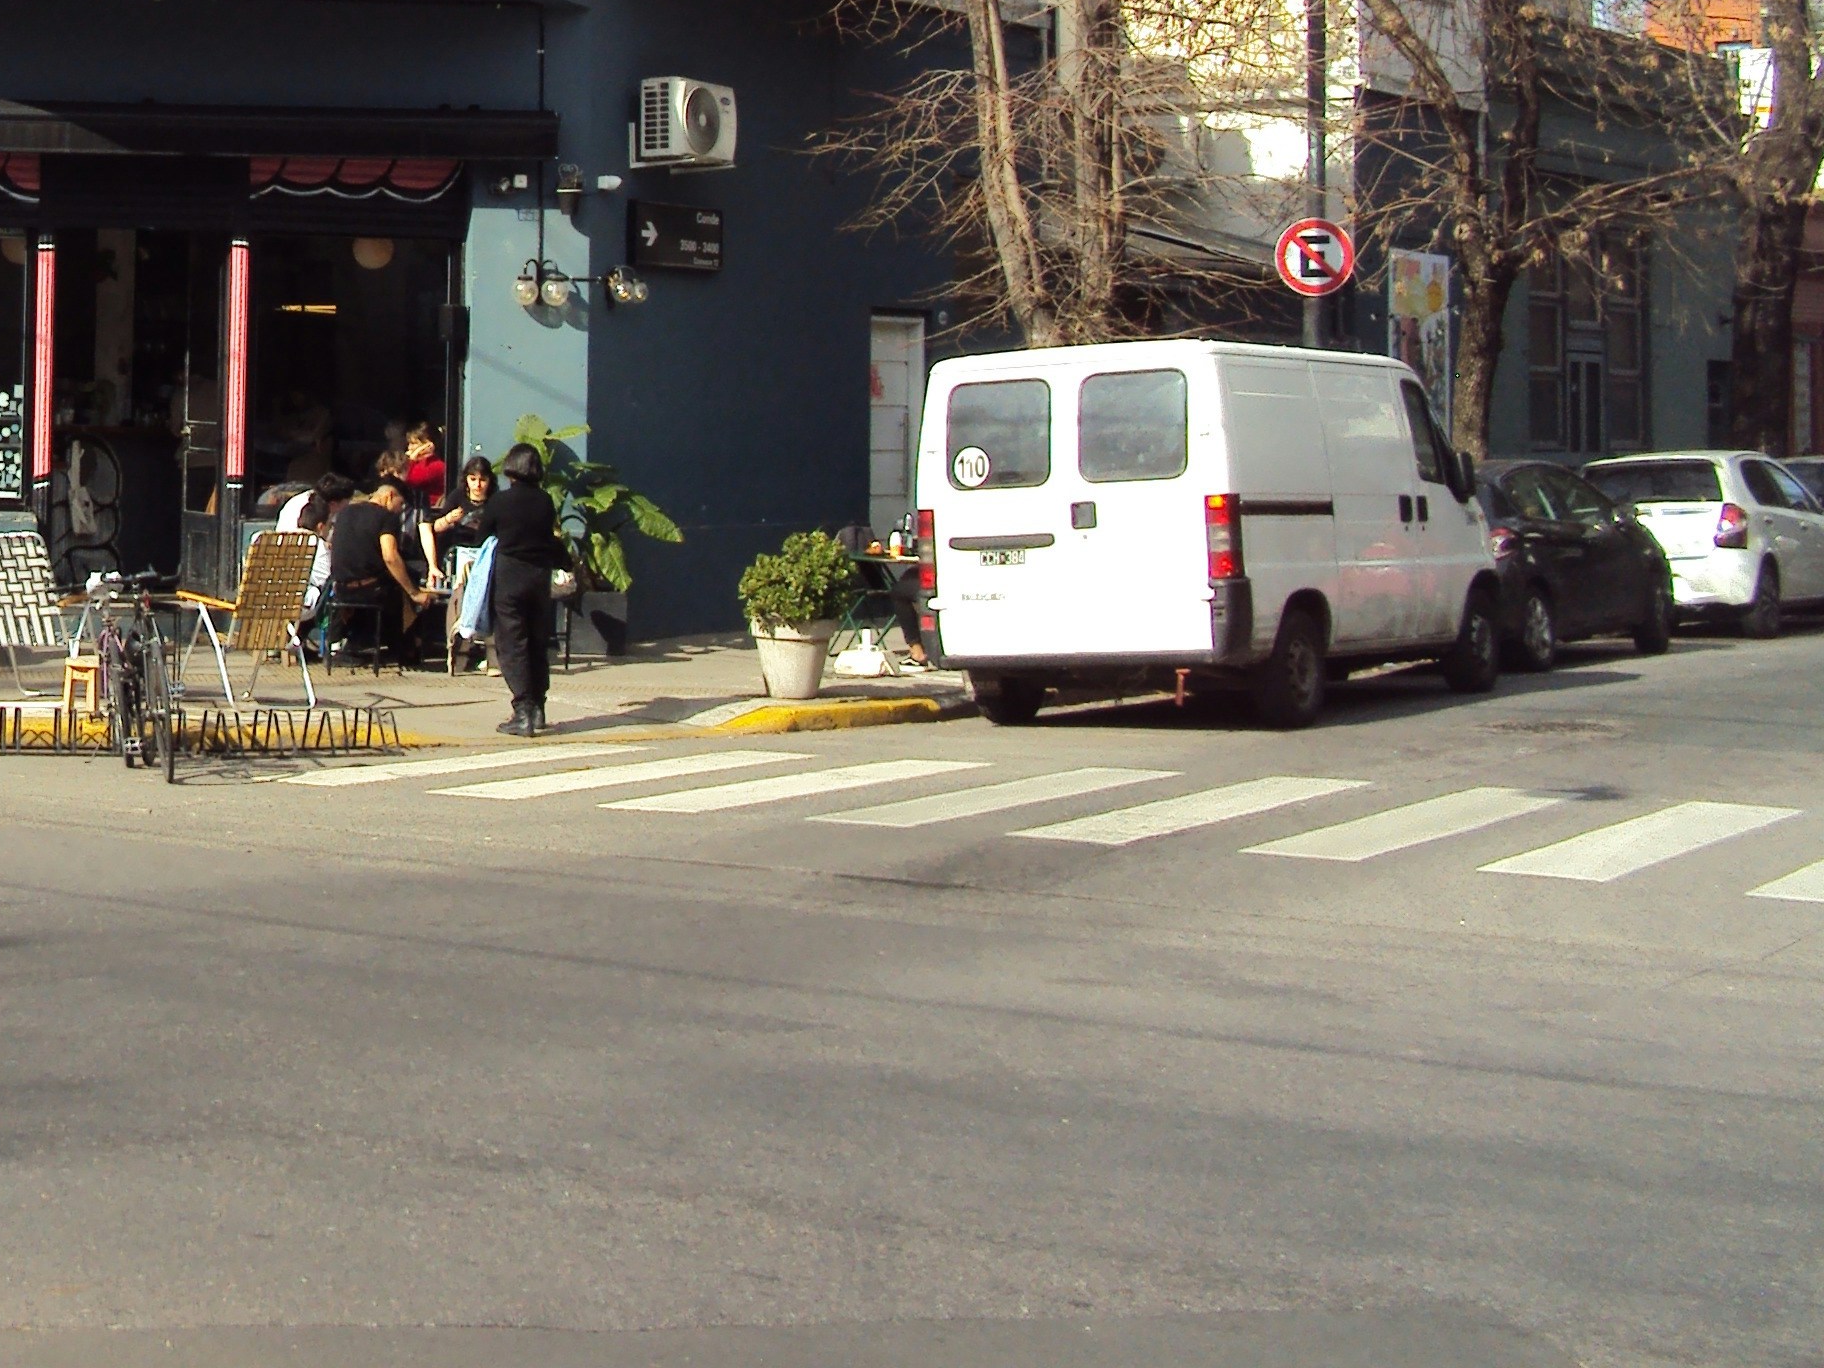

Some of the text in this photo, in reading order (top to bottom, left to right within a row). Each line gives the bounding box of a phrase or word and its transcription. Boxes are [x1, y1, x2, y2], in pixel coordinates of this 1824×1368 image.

[696, 212, 720, 225] Conde
[1300, 235, 1331, 278] E
[958, 455, 986, 478] 110
